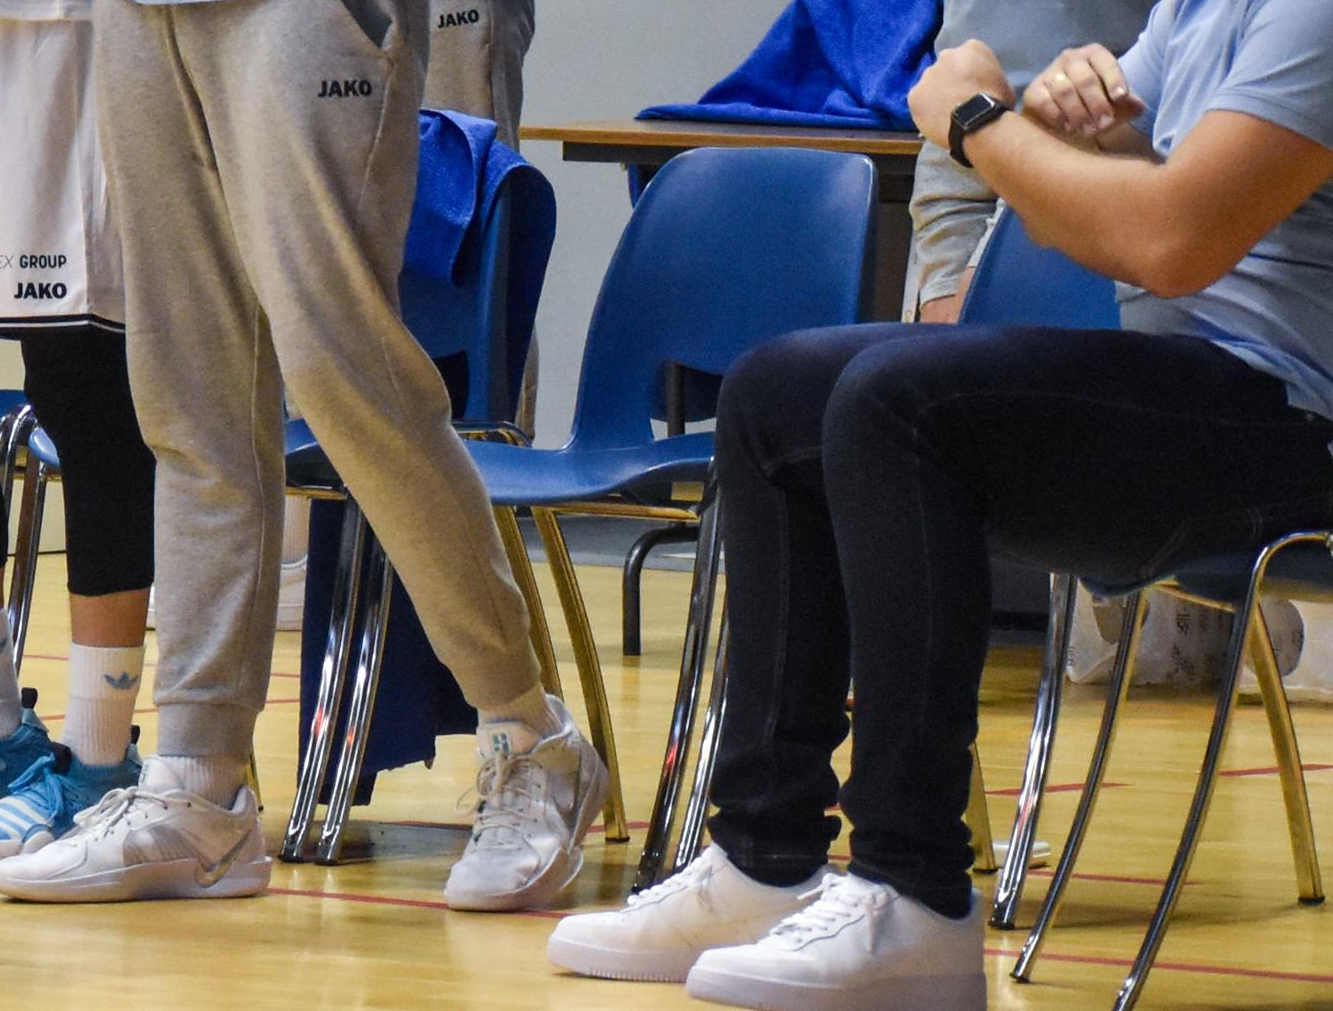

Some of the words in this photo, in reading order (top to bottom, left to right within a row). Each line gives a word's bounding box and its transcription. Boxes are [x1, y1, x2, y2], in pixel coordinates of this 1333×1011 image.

[438, 9, 479, 28] JAKO
[318, 80, 372, 97] JAKO
[19, 255, 67, 269] GROUP
[14, 282, 67, 299] JAKO
